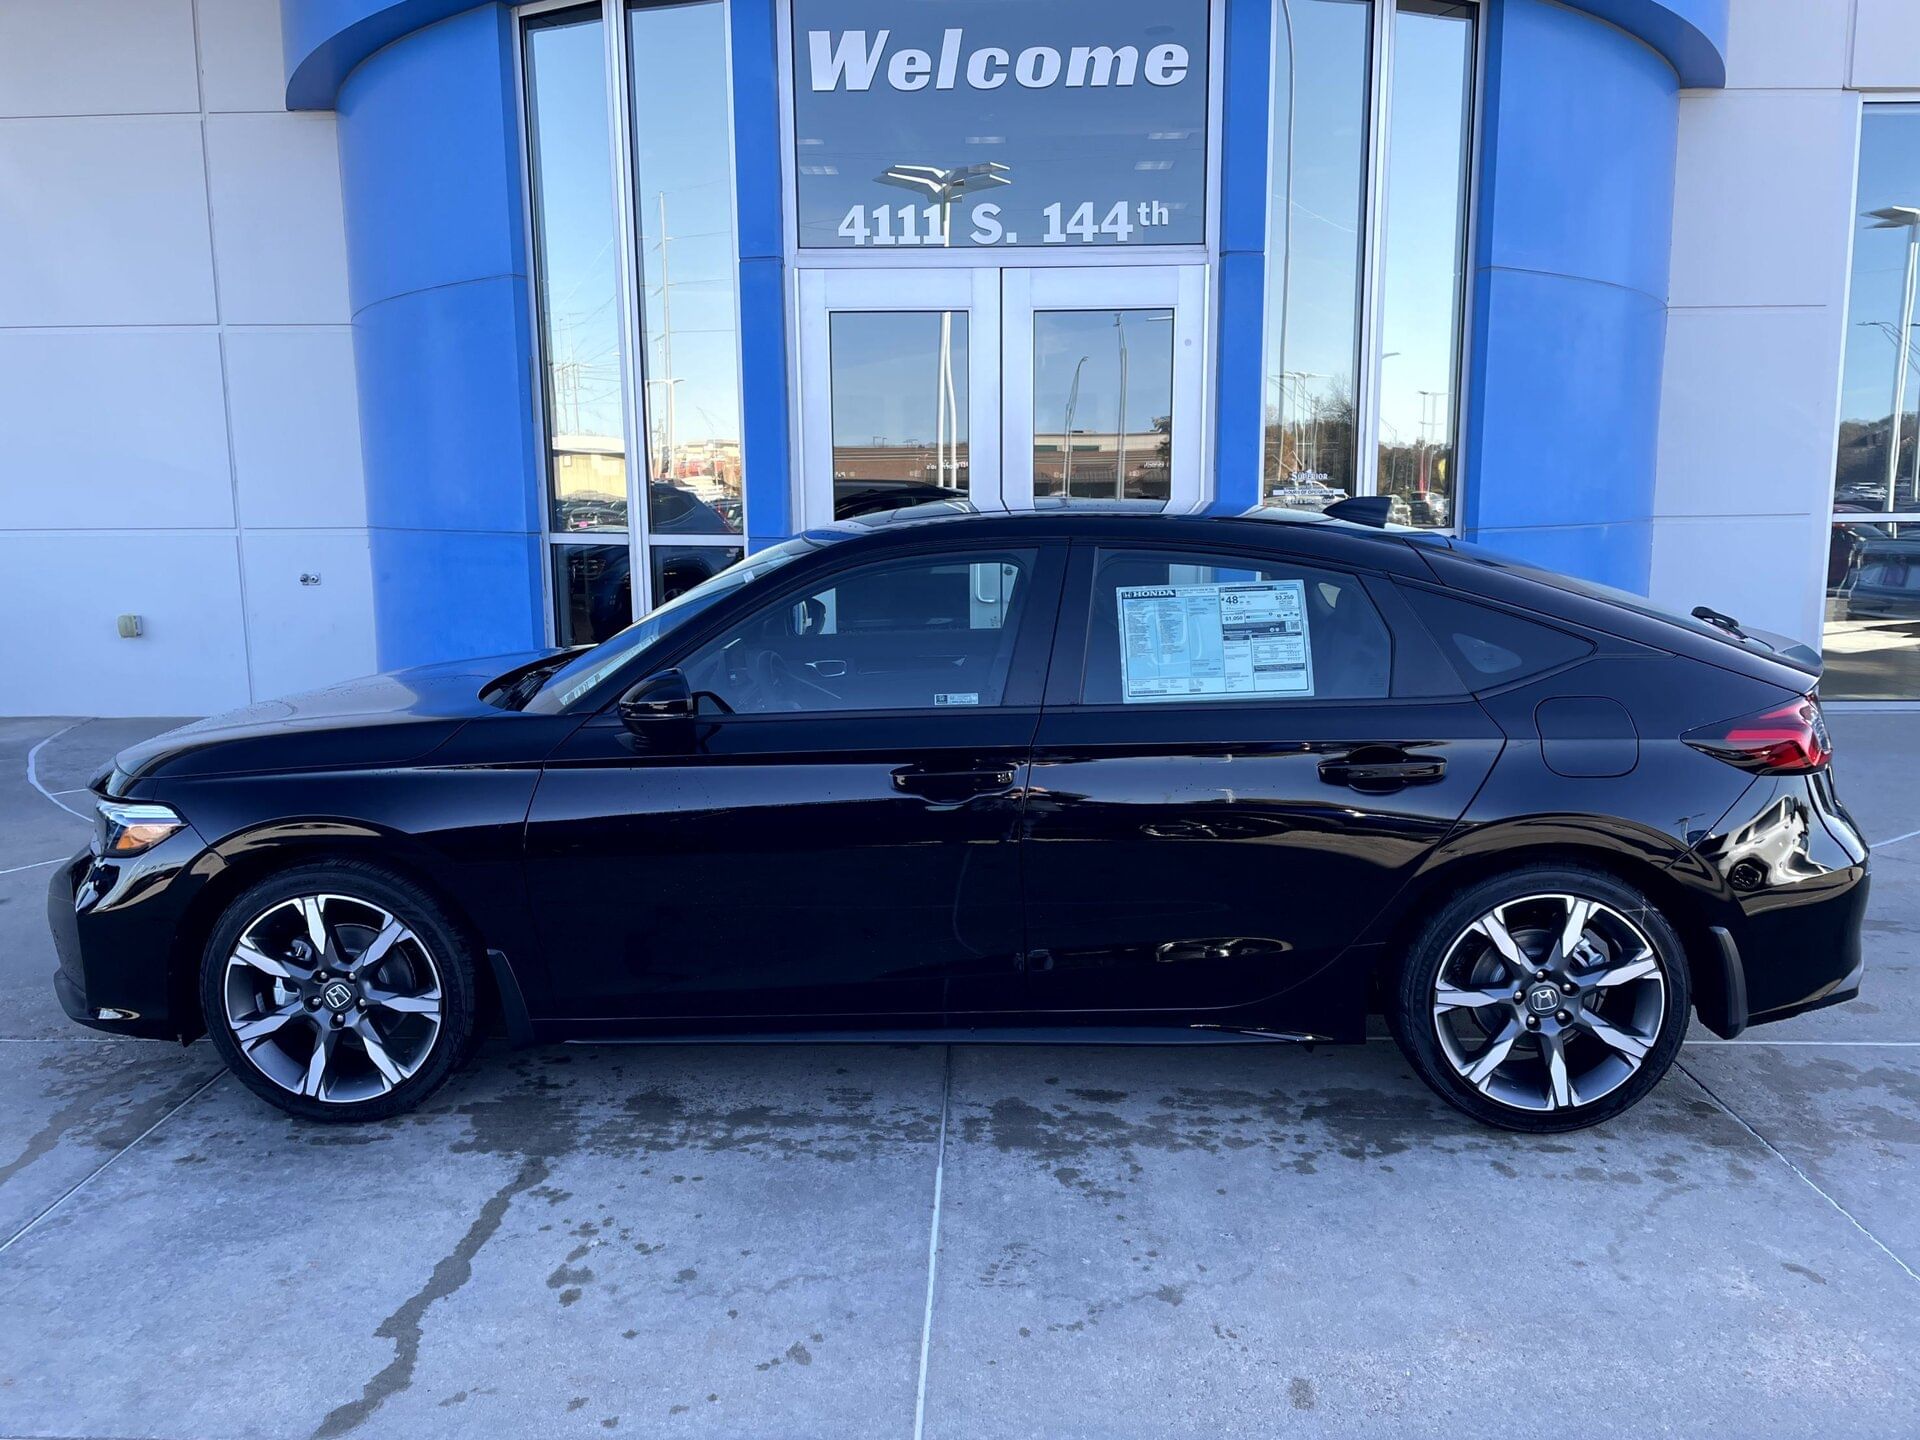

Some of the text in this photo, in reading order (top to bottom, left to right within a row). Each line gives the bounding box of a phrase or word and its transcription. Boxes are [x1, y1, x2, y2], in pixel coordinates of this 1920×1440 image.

[808, 28, 1190, 92] Welcome
[838, 200, 1169, 245] 4111 S. 144th
[1133, 590, 1175, 598] HONDA
[1226, 596, 1239, 605] 48
